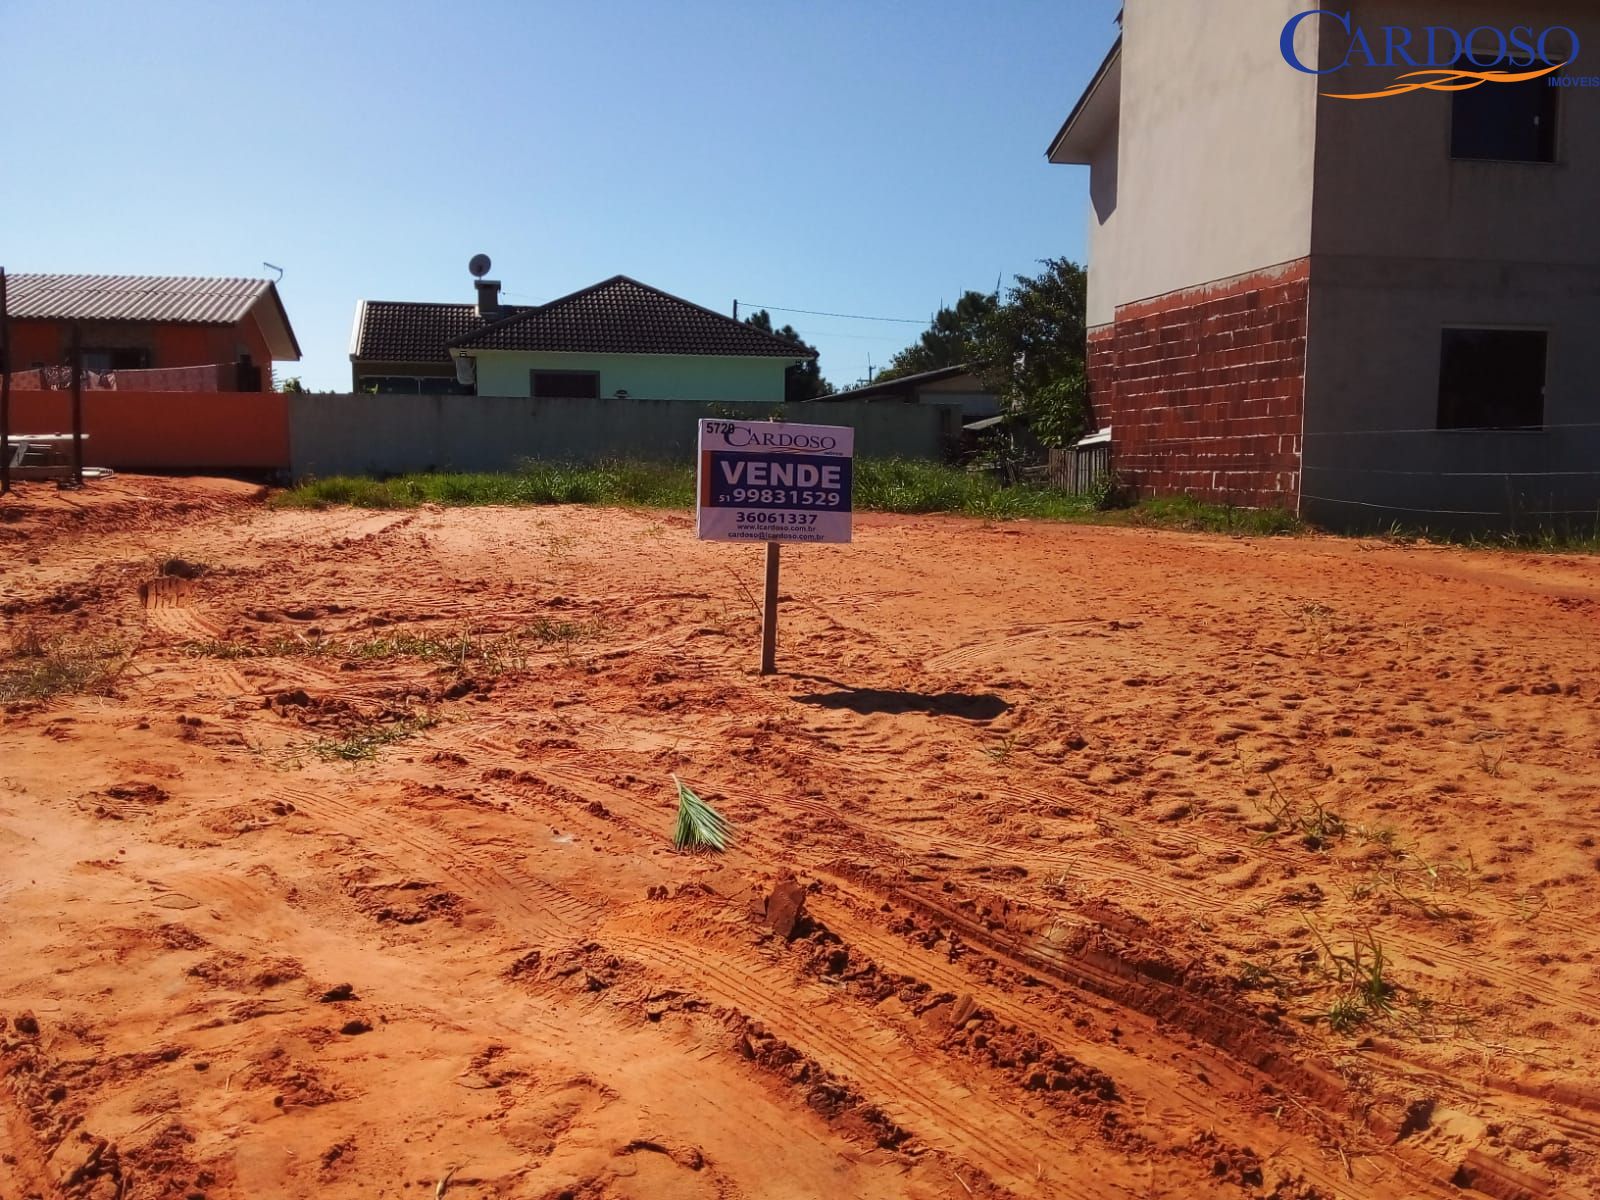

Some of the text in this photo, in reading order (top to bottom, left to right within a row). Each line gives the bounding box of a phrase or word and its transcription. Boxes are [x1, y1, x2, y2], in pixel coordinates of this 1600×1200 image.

[723, 427, 836, 448] CARDOSO
[720, 460, 841, 489] VENDE
[719, 488, 840, 506] 51 99831529
[736, 511, 818, 524] 36061337
